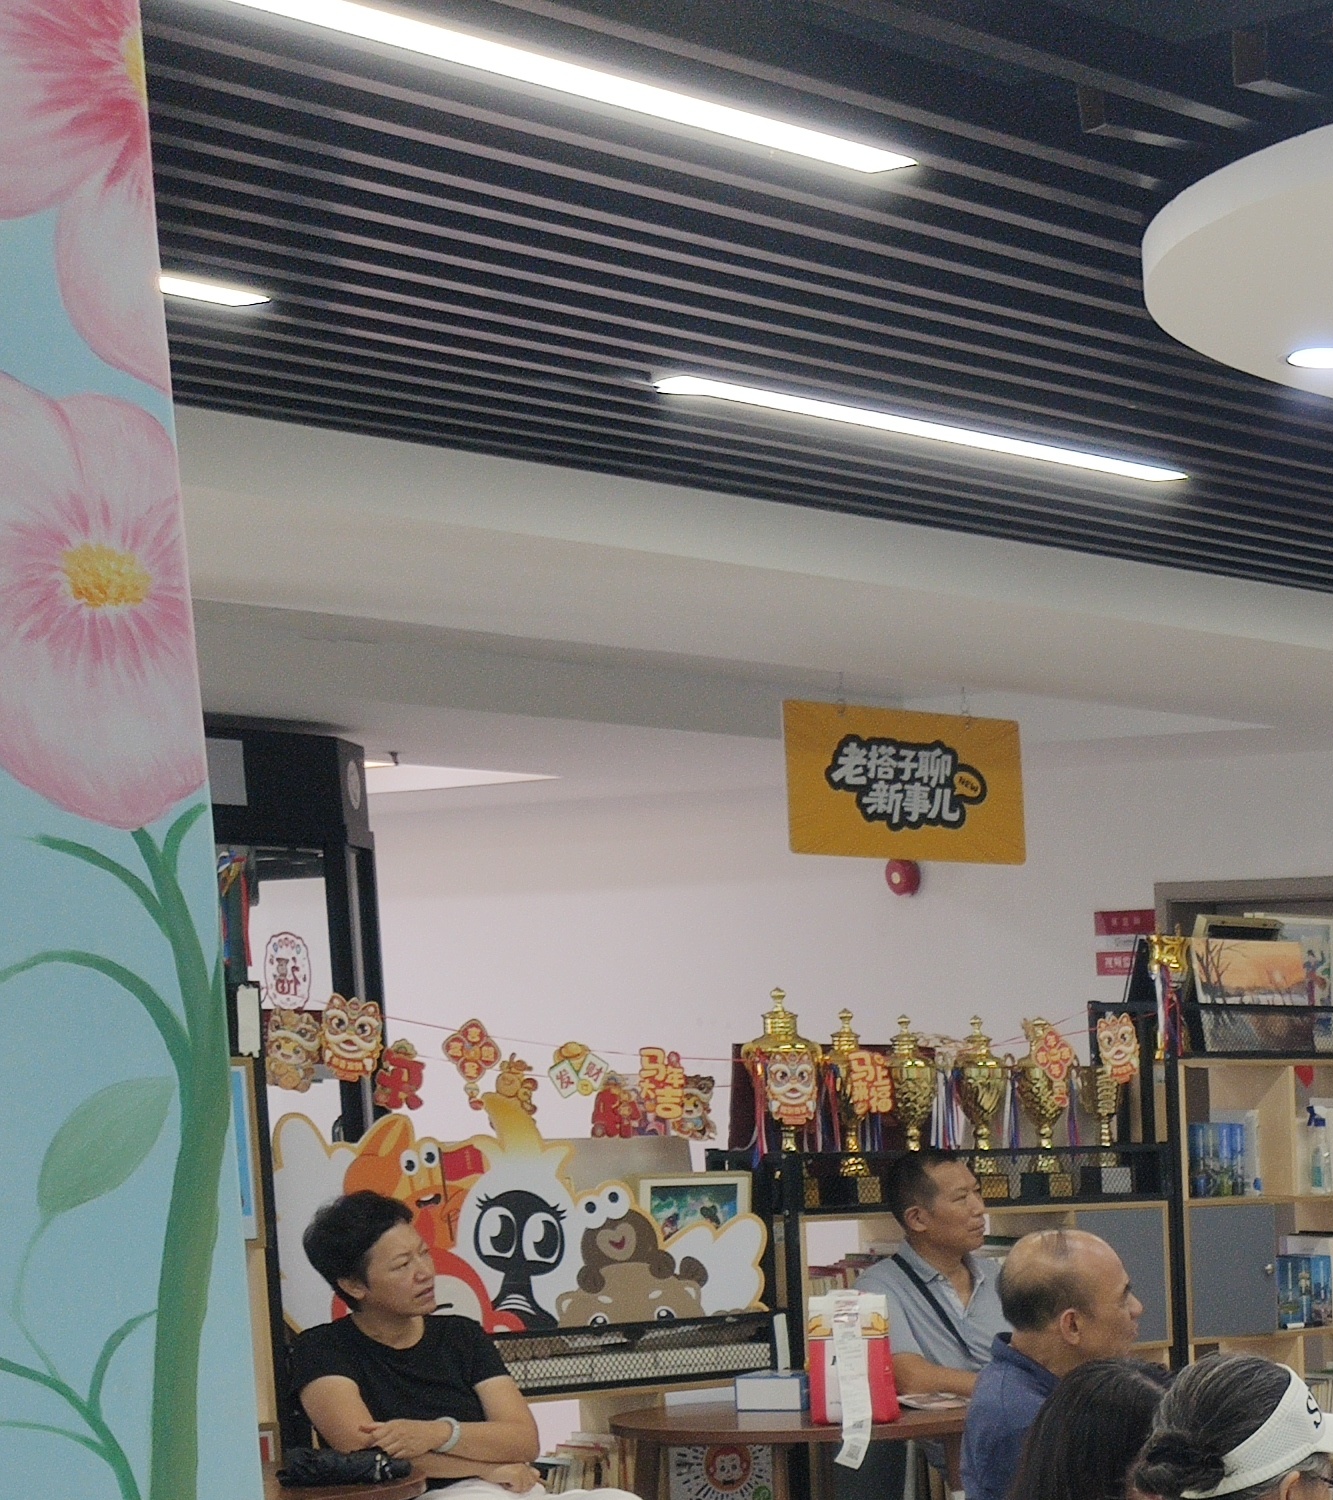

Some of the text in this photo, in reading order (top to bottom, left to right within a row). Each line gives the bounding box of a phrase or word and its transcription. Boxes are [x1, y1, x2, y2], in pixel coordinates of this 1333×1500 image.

[831, 742, 952, 788] 老搭子聊
[862, 780, 960, 823] 新事儿
